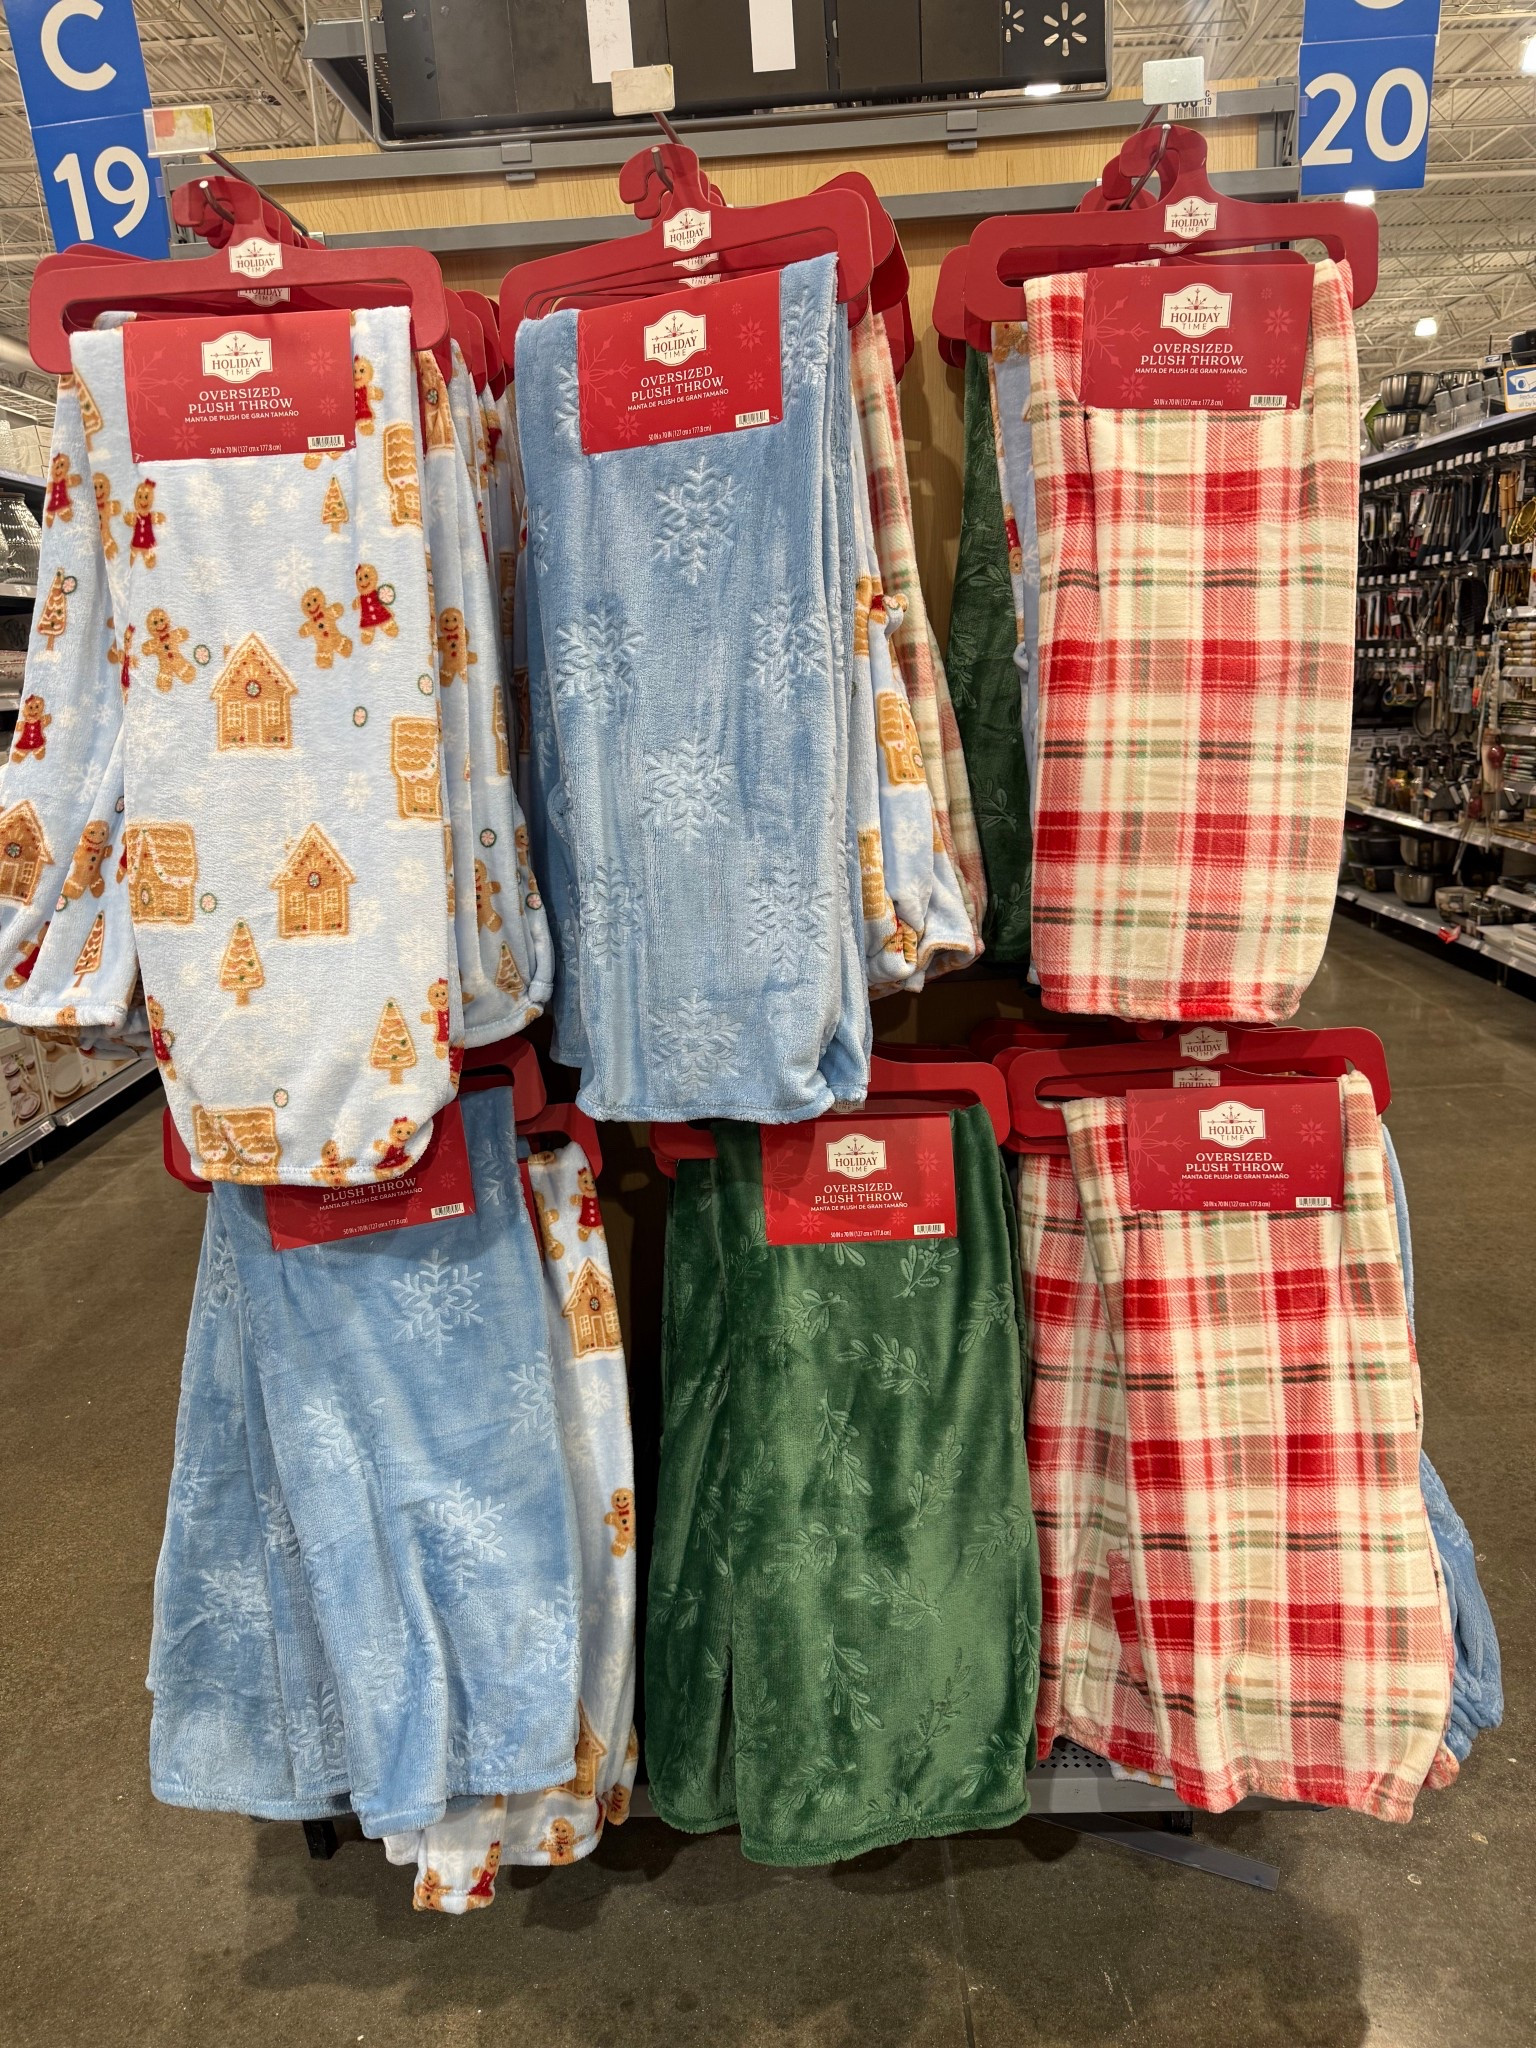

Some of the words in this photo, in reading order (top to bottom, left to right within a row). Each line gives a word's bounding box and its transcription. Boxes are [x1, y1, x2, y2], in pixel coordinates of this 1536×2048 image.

[41, 0, 117, 91] C
[1204, 97, 1212, 105] 19
[1301, 67, 1429, 166] 20
[53, 145, 150, 241] 19
[1172, 218, 1209, 227] HOLIDAY
[670, 228, 704, 242] HOLIDAY
[237, 258, 274, 268] HOLIDAY
[1171, 313, 1220, 323] HOLIDAY
[653, 336, 697, 354] HOLIDAY
[1153, 343, 1233, 353] OVERSIZED
[664, 350, 686, 359] TIME
[212, 358, 261, 370] HOLIDAY
[1141, 355, 1185, 366] PLUSH
[1190, 355, 1244, 365] THROW
[641, 366, 712, 388] OVERSIZED
[199, 387, 280, 401] OVERSIZED
[632, 385, 671, 402] PLUSH
[675, 376, 724, 394] THROW
[628, 403, 648, 411] MANTA
[658, 399, 675, 407] PLUSH
[703, 388, 728, 399] TAMAÑO
[189, 402, 234, 414] PLUSH
[239, 398, 292, 410] THROW
[271, 410, 299, 418] TAMAÑO
[673, 429, 681, 437] (127
[273, 443, 281, 451] cm)
[1187, 1044, 1221, 1052] HOLIDAY
[1209, 1126, 1255, 1135] HOLIDAY
[835, 1157, 878, 1167] HOLIDAY
[1196, 1153, 1272, 1162] OVERSIZED
[1186, 1163, 1228, 1172] PLUSH
[1232, 1162, 1284, 1172] THROW
[323, 1187, 364, 1203] PLUSH
[368, 1178, 416, 1194] THROW
[824, 1183, 892, 1193] OVERSIZED
[320, 1203, 341, 1211] MANTA
[397, 1187, 422, 1196] TAMAÑO
[815, 1194, 853, 1204] PLUSH
[857, 1192, 903, 1202] THROW
